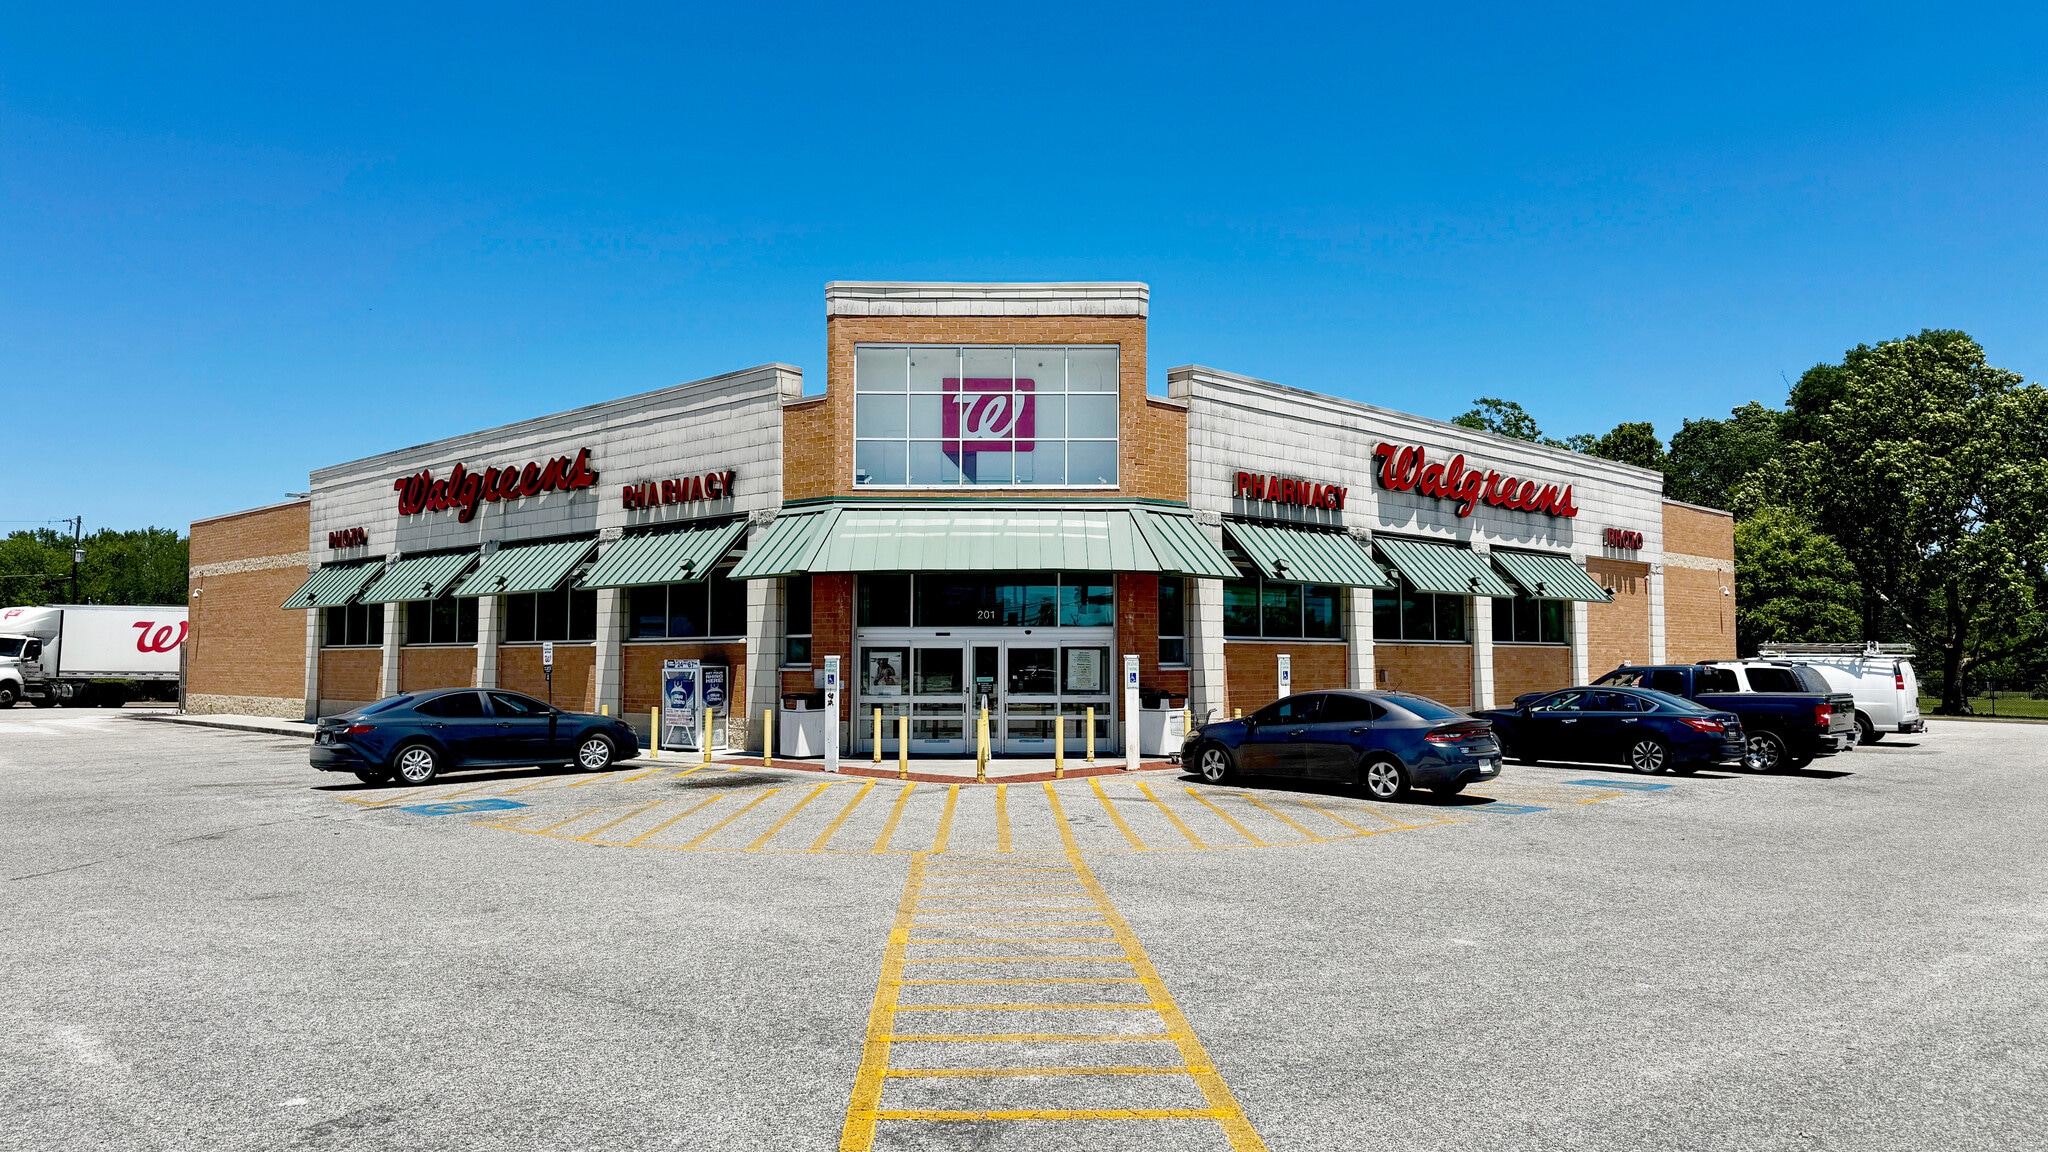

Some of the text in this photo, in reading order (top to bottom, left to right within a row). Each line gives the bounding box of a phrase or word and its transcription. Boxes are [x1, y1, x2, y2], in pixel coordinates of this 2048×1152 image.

[953, 390, 1025, 441] W
[394, 447, 599, 523] Walgreens
[623, 471, 734, 509] PHARMACY
[1234, 471, 1348, 510] PHARMACY
[1373, 442, 1579, 518] Walgreens
[328, 526, 367, 549] PHOTO
[1605, 527, 1643, 549] PHOTO
[977, 610, 995, 620] 201
